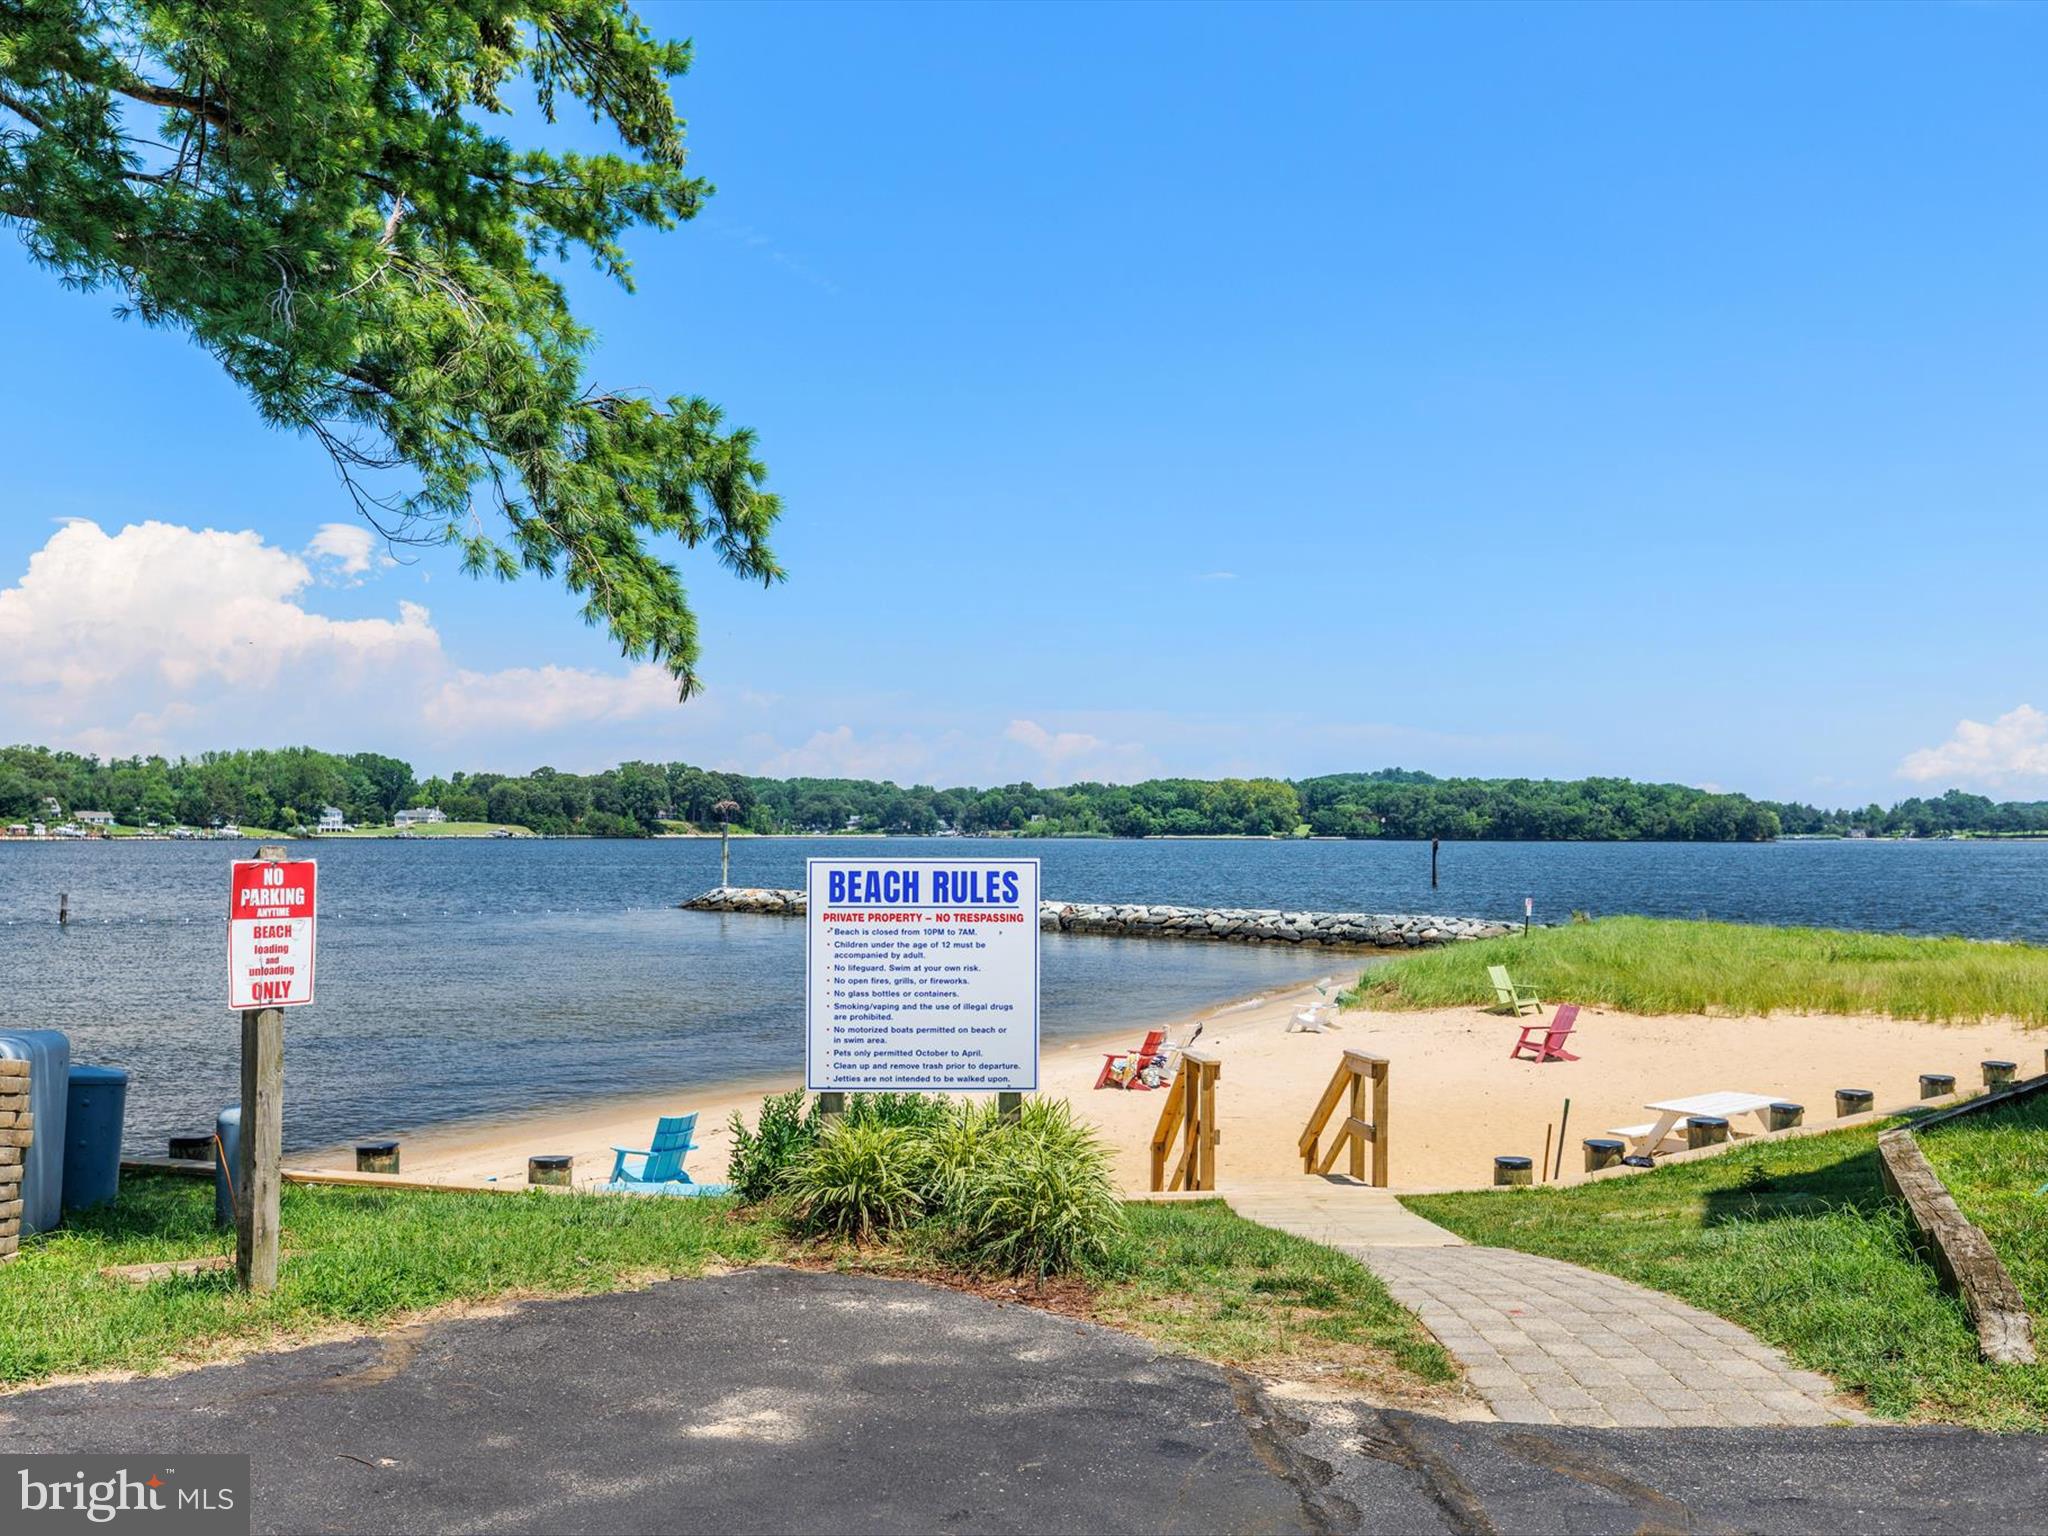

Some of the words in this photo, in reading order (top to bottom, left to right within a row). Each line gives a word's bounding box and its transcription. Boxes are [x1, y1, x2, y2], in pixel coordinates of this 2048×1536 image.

[263, 868, 283, 886] NO
[829, 870, 919, 903] BEACH
[933, 870, 1019, 903] RULES
[241, 888, 305, 906] PARKING
[257, 907, 290, 917] ANYTIME
[823, 913, 864, 923] PRIVATE
[868, 913, 923, 923] PROPERTY
[936, 913, 950, 923] NO
[954, 913, 1024, 923] TRESPASSING
[253, 925, 292, 939] BEACH
[254, 945, 289, 954] loading
[249, 965, 294, 976] unloading
[871, 978, 891, 986] fires,
[894, 978, 916, 986] grills,
[252, 981, 292, 1000] ONLY
[848, 991, 869, 999] glass
[834, 1003, 899, 1011] Smoking/vaping
[963, 1003, 987, 1011] illegal
[990, 1003, 1013, 1011] drugs
[916, 1026, 955, 1034] permitted
[971, 1026, 996, 1034] beach
[854, 1050, 871, 1058] only
[874, 1050, 913, 1058] permitted
[962, 1050, 982, 1058] April.
[946, 1062, 965, 1070] prior
[978, 1062, 1021, 1070] departure.
[833, 1075, 861, 1083] Jetties
[895, 1075, 930, 1083] intended
[944, 1075, 954, 1083] be
[957, 1075, 985, 1083] walked
